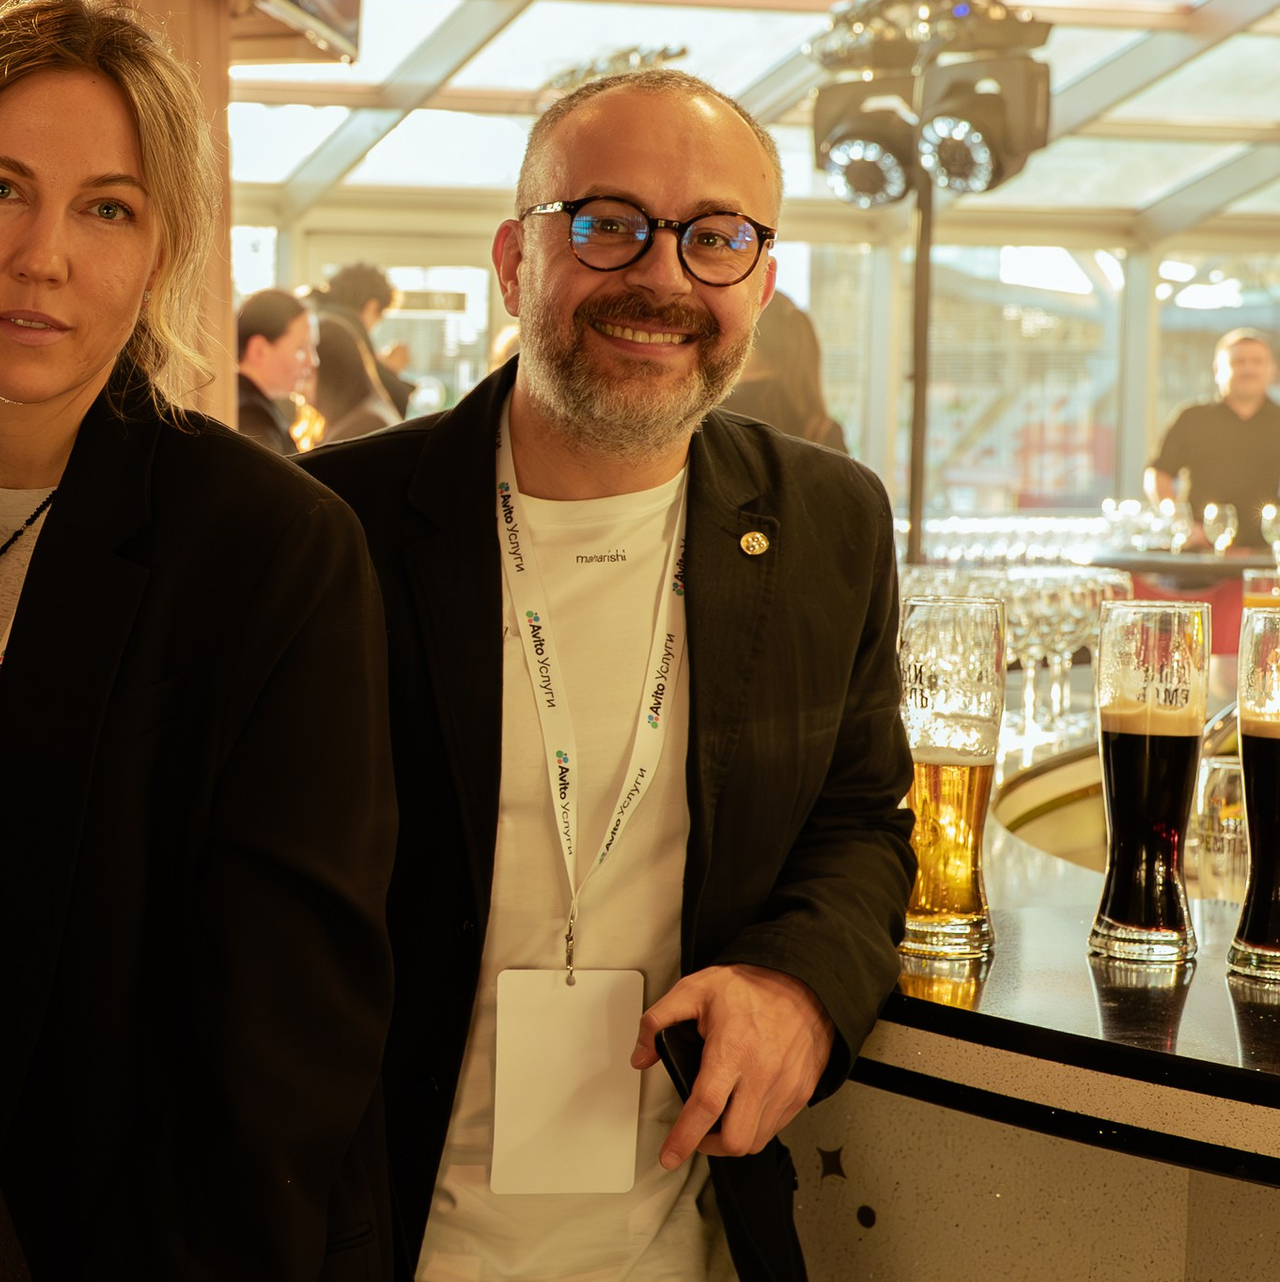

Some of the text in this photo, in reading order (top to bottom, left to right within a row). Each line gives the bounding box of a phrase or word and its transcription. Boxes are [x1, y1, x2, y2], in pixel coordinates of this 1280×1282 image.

[501, 494, 525, 573] Avito Услуги
[529, 622, 556, 709] Avito Услуги
[648, 633, 676, 717] Avito Услуги
[558, 764, 574, 856] Avito Услуги
[602, 767, 647, 852] Avito Услуги
